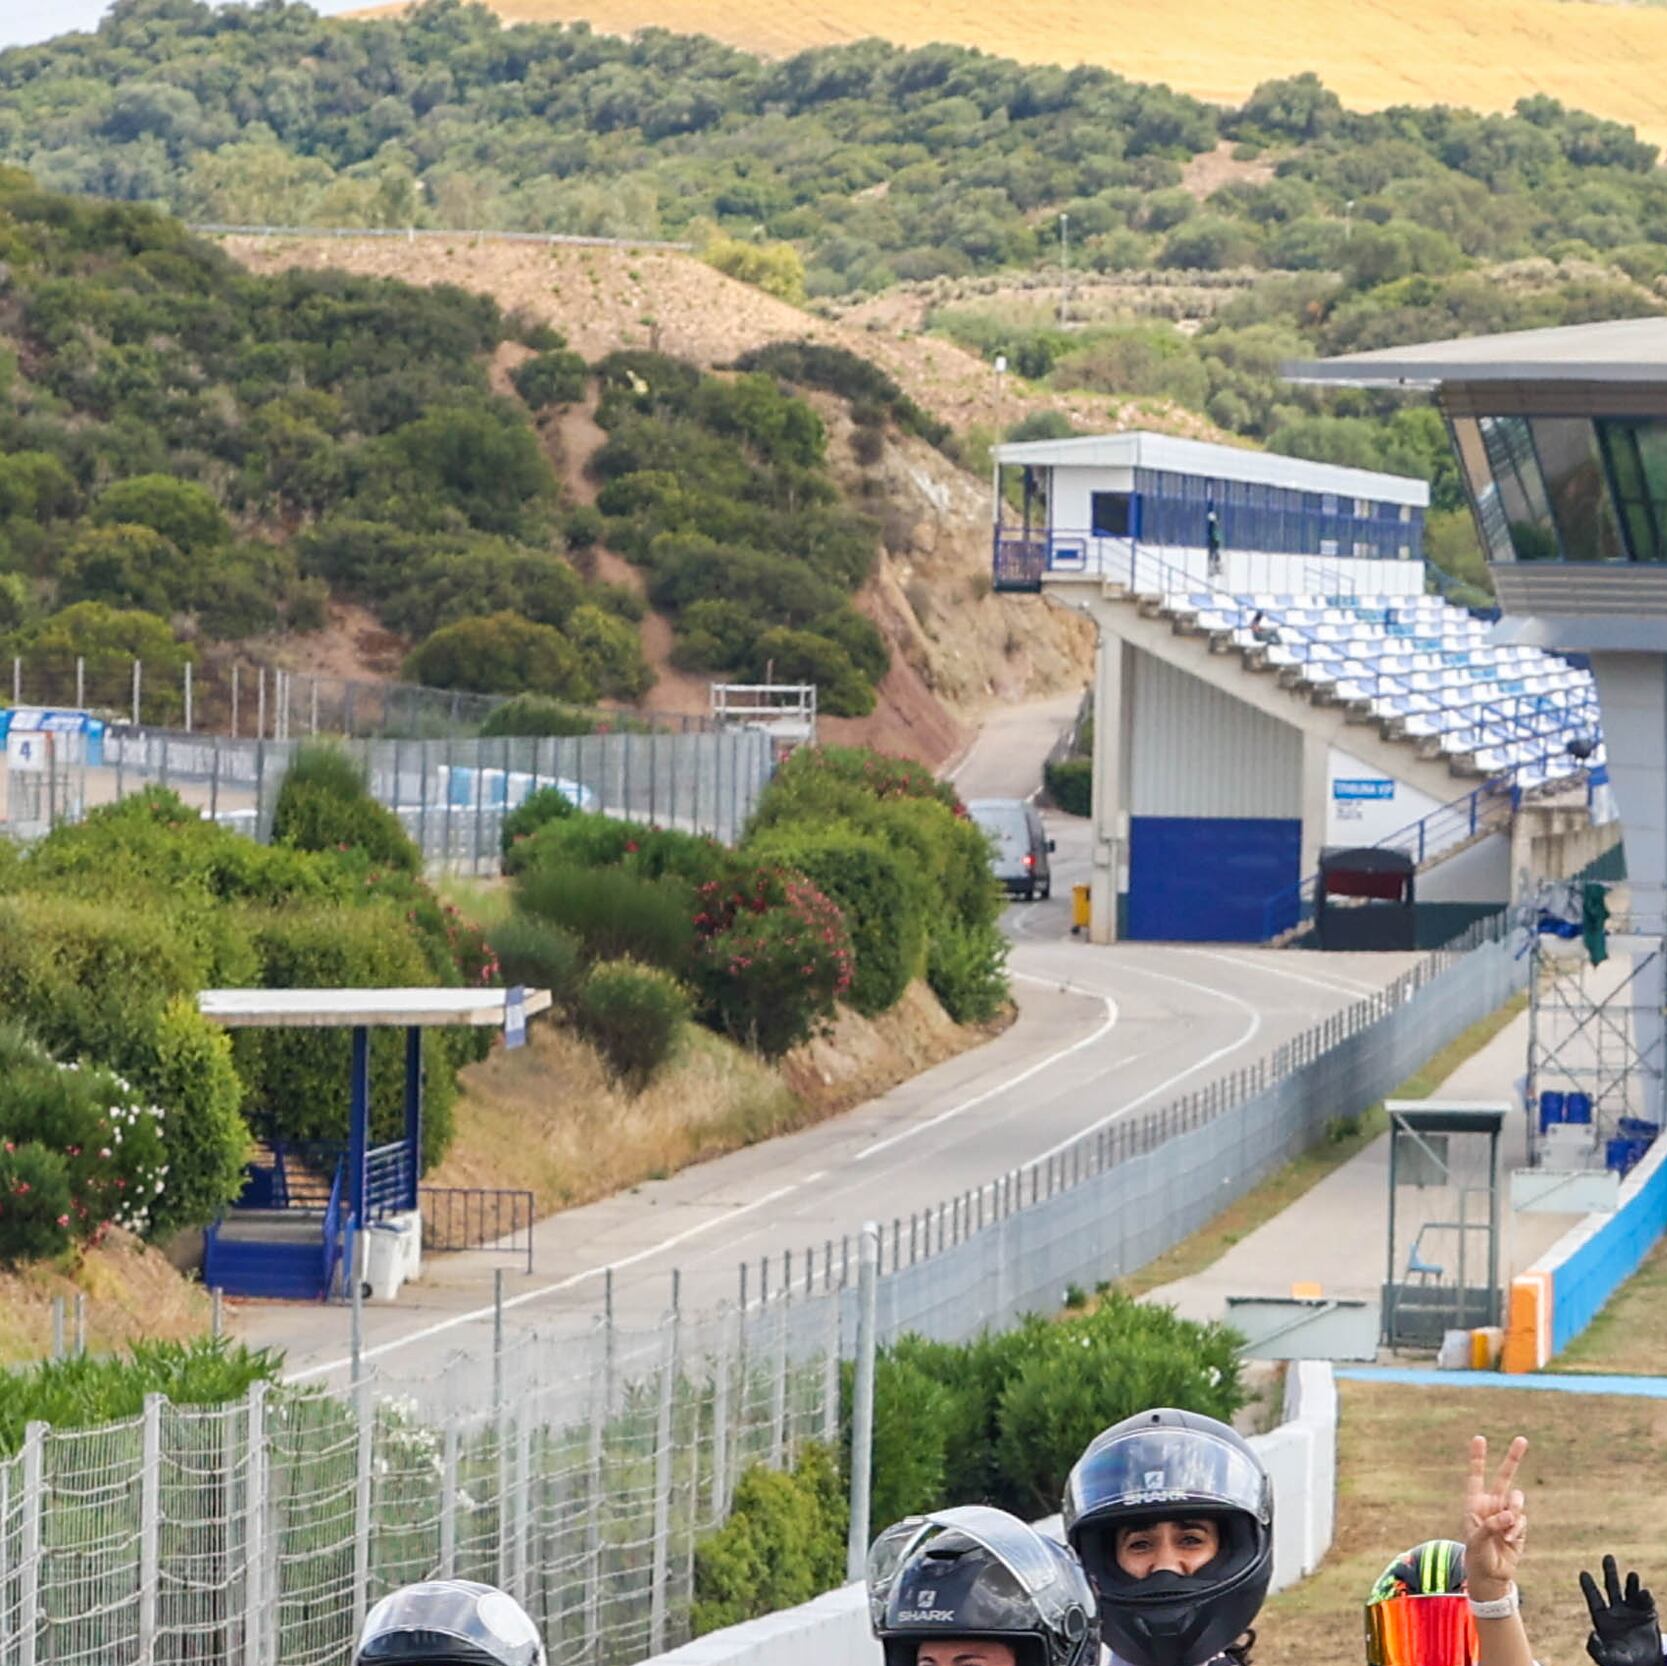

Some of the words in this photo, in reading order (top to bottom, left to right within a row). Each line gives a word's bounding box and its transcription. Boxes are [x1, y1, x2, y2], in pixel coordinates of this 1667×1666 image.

[20, 741, 31, 762] 4
[1123, 1489, 1189, 1506] SHARK
[899, 1609, 954, 1622] SHARK
